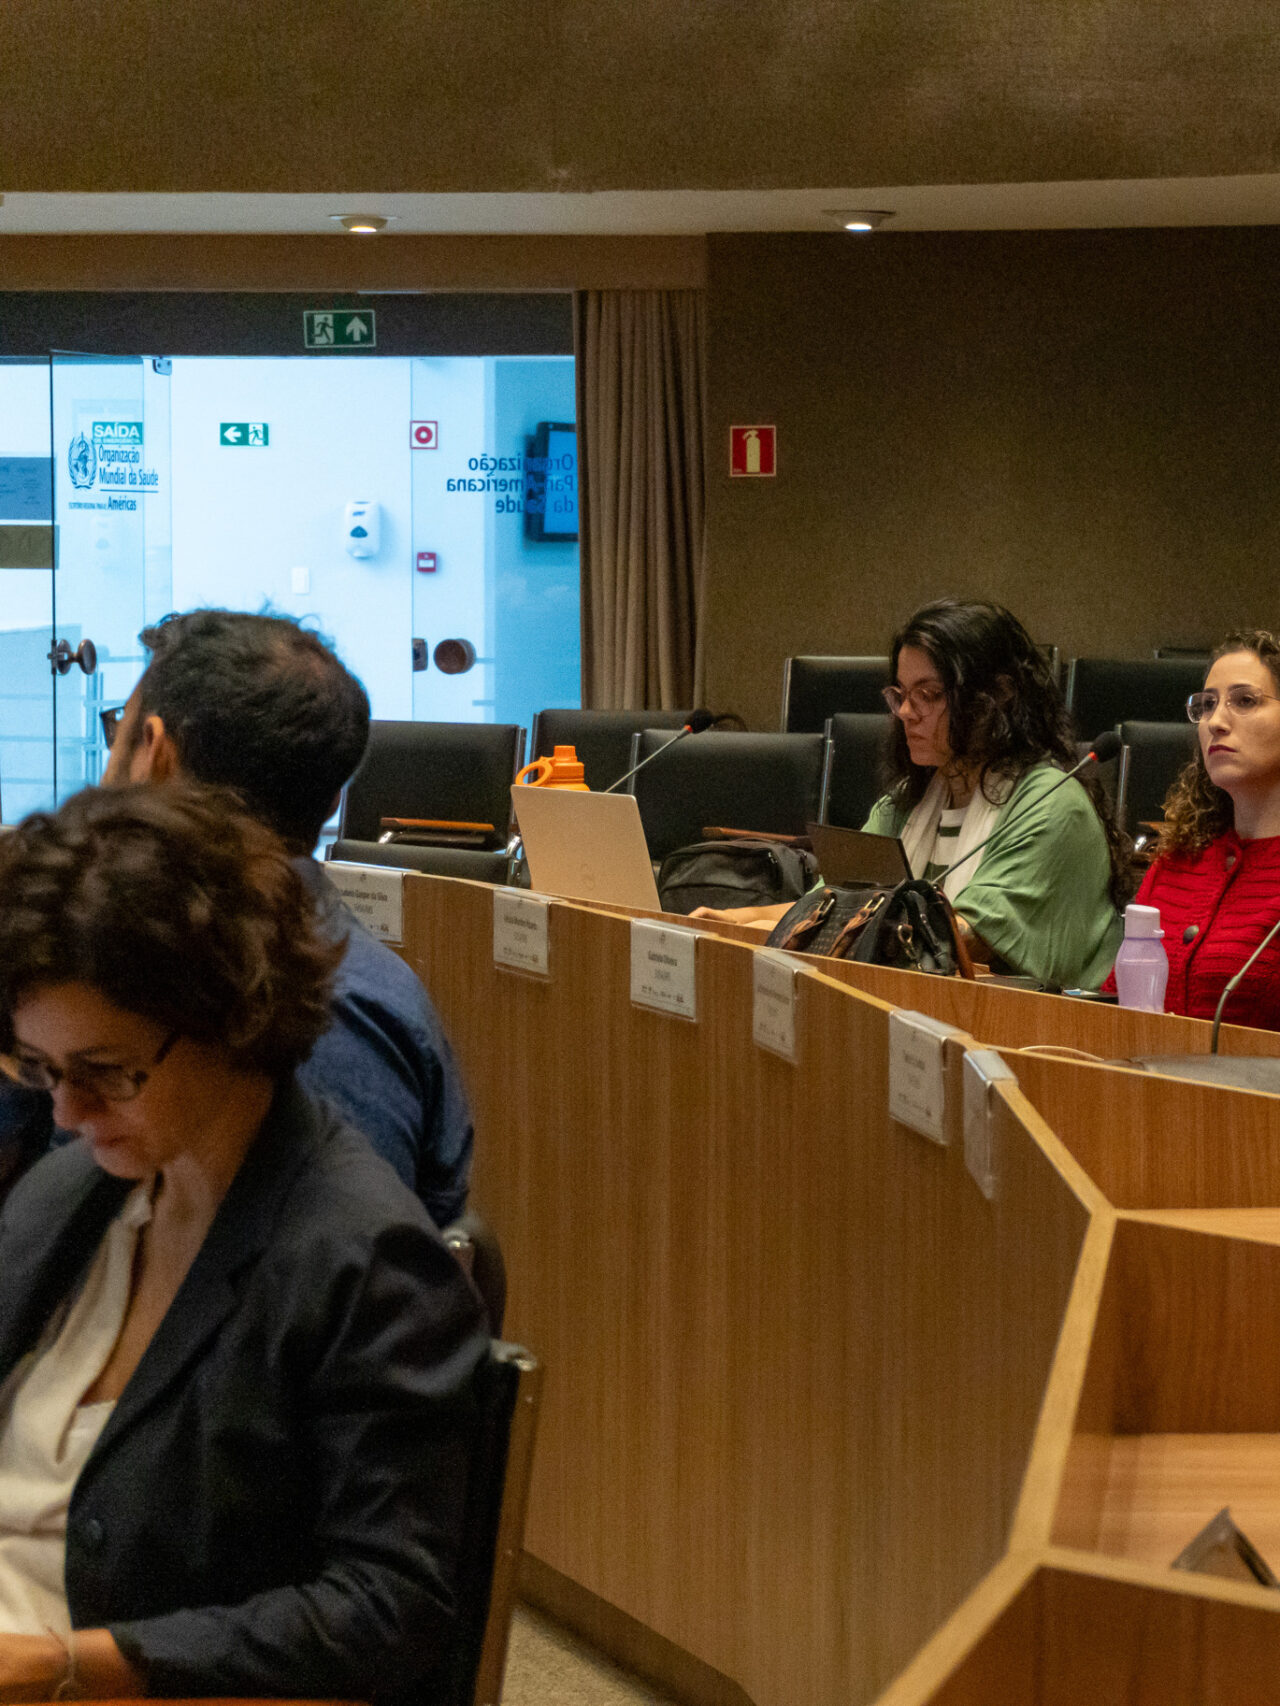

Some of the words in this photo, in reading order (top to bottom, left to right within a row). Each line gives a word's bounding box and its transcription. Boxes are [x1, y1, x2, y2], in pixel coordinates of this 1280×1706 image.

[94, 422, 140, 438] SAÍDA
[98, 444, 140, 467] Organização
[99, 466, 127, 484] Mundial
[128, 468, 137, 485] da
[138, 468, 159, 486] Saúde
[107, 495, 137, 511] Américas
